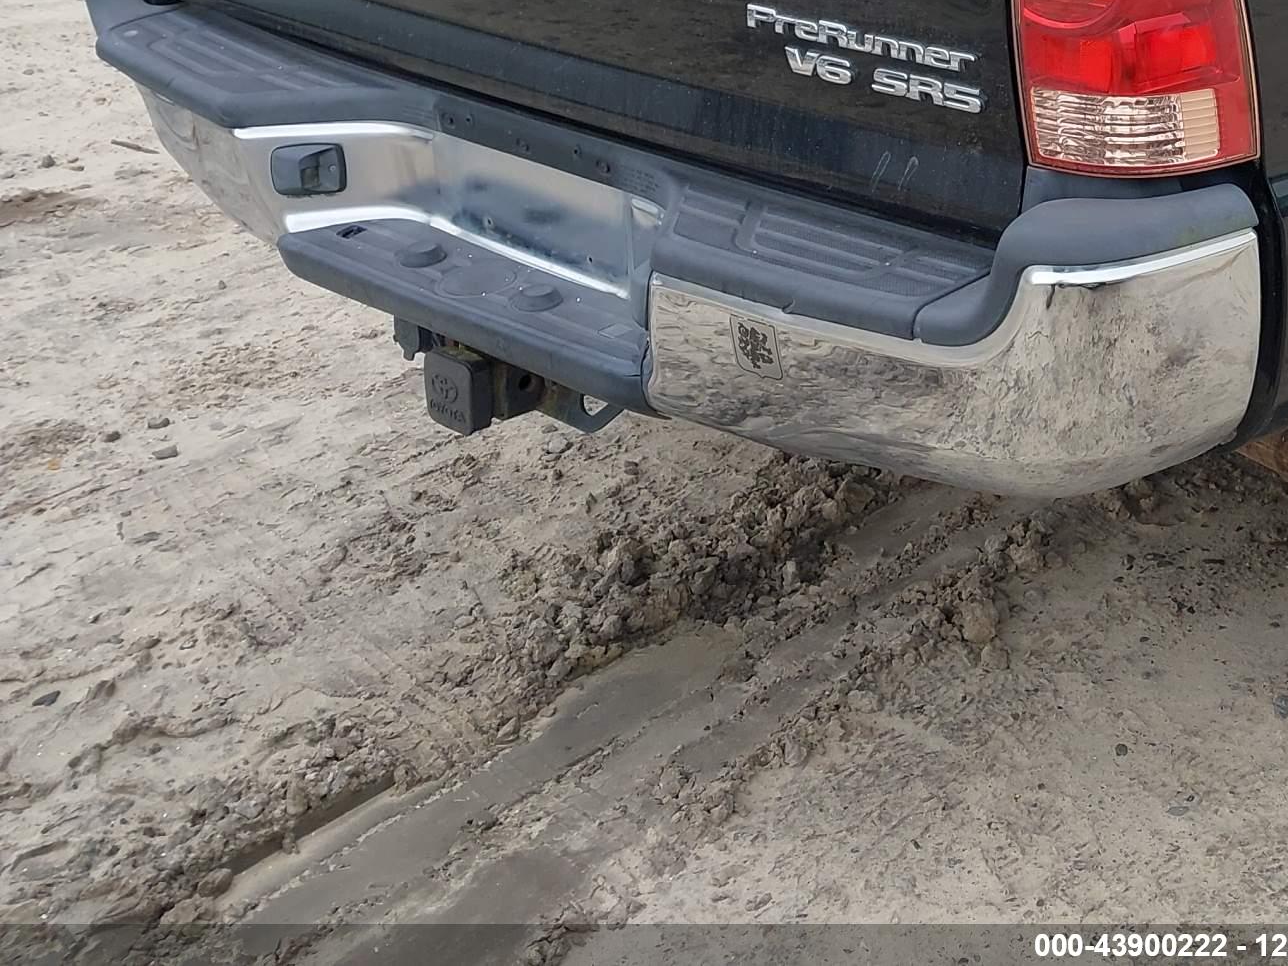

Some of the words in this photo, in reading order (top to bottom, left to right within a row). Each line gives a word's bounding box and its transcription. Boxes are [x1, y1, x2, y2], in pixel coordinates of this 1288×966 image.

[747, 3, 979, 72] PreRunner
[784, 46, 853, 85] V6
[871, 68, 984, 114] SR5
